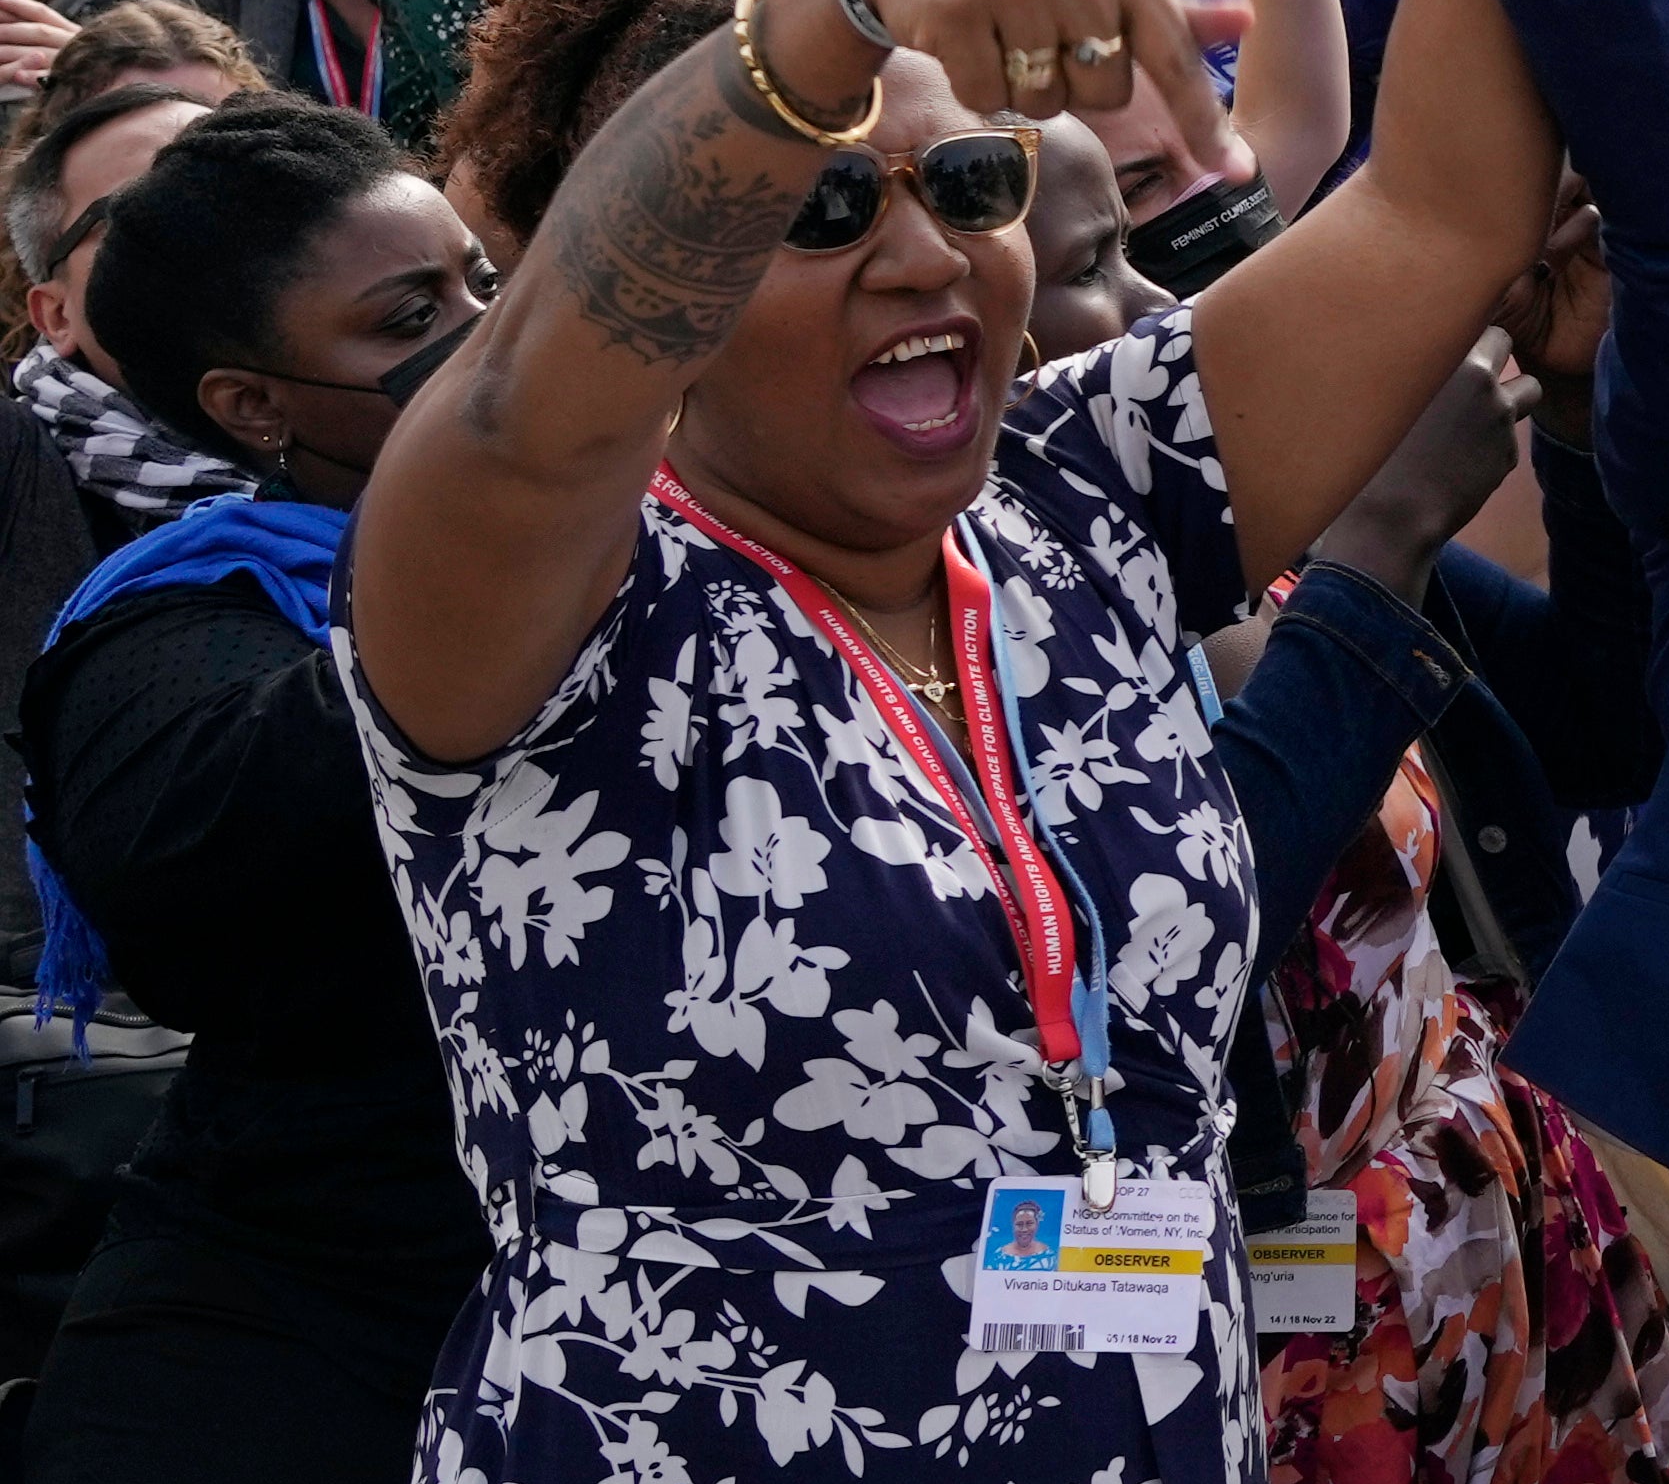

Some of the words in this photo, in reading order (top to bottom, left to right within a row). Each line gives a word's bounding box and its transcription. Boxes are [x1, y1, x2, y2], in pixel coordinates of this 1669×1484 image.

[662, 479, 692, 503] FOR
[741, 538, 793, 576] ACTION
[963, 608, 979, 661] ACTION
[970, 661, 995, 725] CLIMATE
[819, 609, 862, 657] HUMAN
[857, 656, 898, 705] RIGHTS
[892, 705, 917, 735] AND
[912, 734, 939, 774] CIVIC
[936, 774, 969, 821] SPACE
[983, 724, 1001, 754] FOR
[987, 754, 1009, 804] SPACE
[1001, 803, 1022, 837] CIVIC
[1015, 833, 1036, 866] AND
[1026, 857, 1053, 916] RIGHTS
[1038, 914, 1062, 977] HUMAN
[1137, 1187, 1150, 1198] 27
[1064, 1223, 1098, 1237] Status
[1101, 1224, 1114, 1237] of
[1166, 1213, 1180, 1223] on
[1183, 1210, 1199, 1223] the
[1342, 1210, 1355, 1222] for
[1094, 1253, 1171, 1269] OBSERVER
[1252, 1248, 1326, 1261] OBSERVER
[1003, 1278, 1049, 1293] Vivania
[1053, 1279, 1107, 1294] Ditukana
[1110, 1280, 1169, 1296] Tatawaqa
[1269, 1315, 1281, 1325] 14
[1290, 1315, 1300, 1325] 18
[1303, 1315, 1323, 1325] Nov
[1324, 1315, 1336, 1325] 22
[1129, 1334, 1139, 1345] 18
[1142, 1334, 1163, 1345] Nov
[1165, 1334, 1177, 1345] 22
